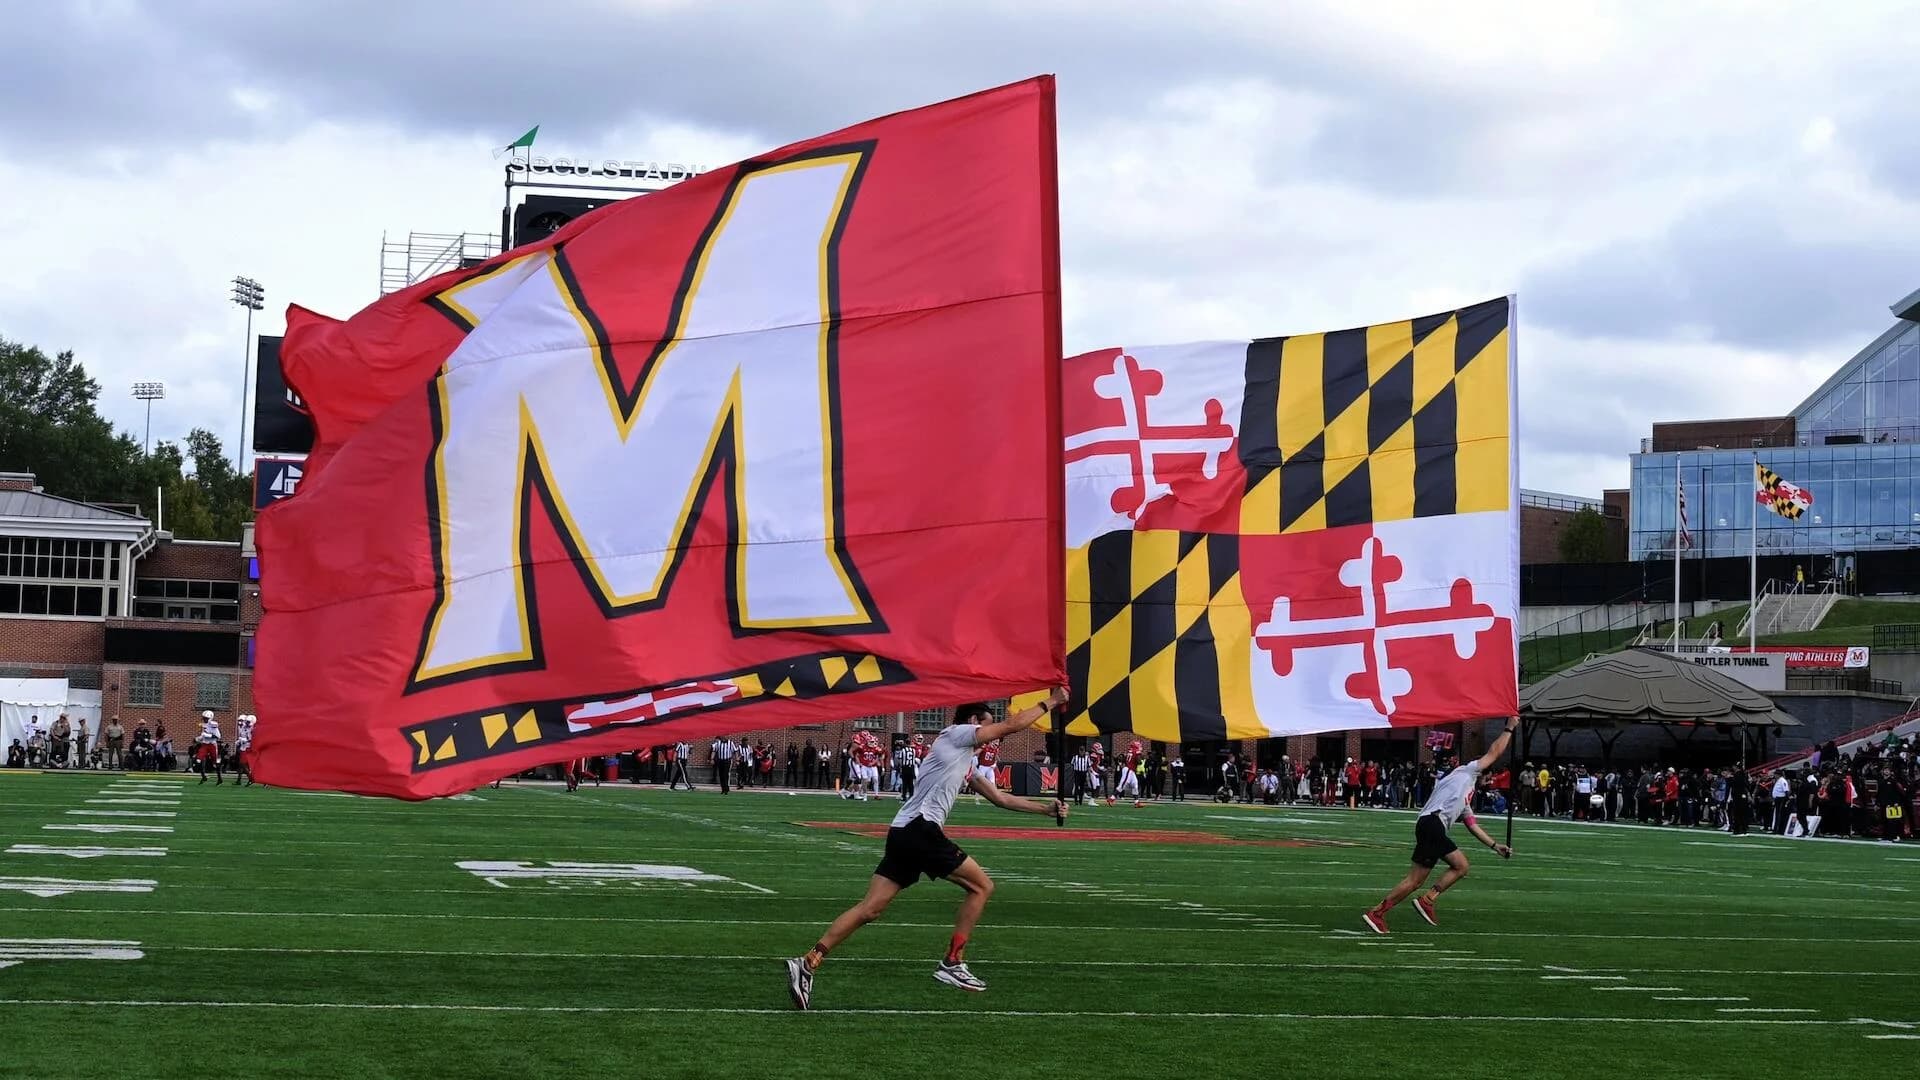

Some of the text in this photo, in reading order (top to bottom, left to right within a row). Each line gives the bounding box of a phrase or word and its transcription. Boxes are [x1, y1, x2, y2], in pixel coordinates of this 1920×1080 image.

[402, 138, 892, 697] M
[1694, 657, 1770, 667] BUTLER TUNNEL
[1804, 651, 1845, 663] ATHLETES
